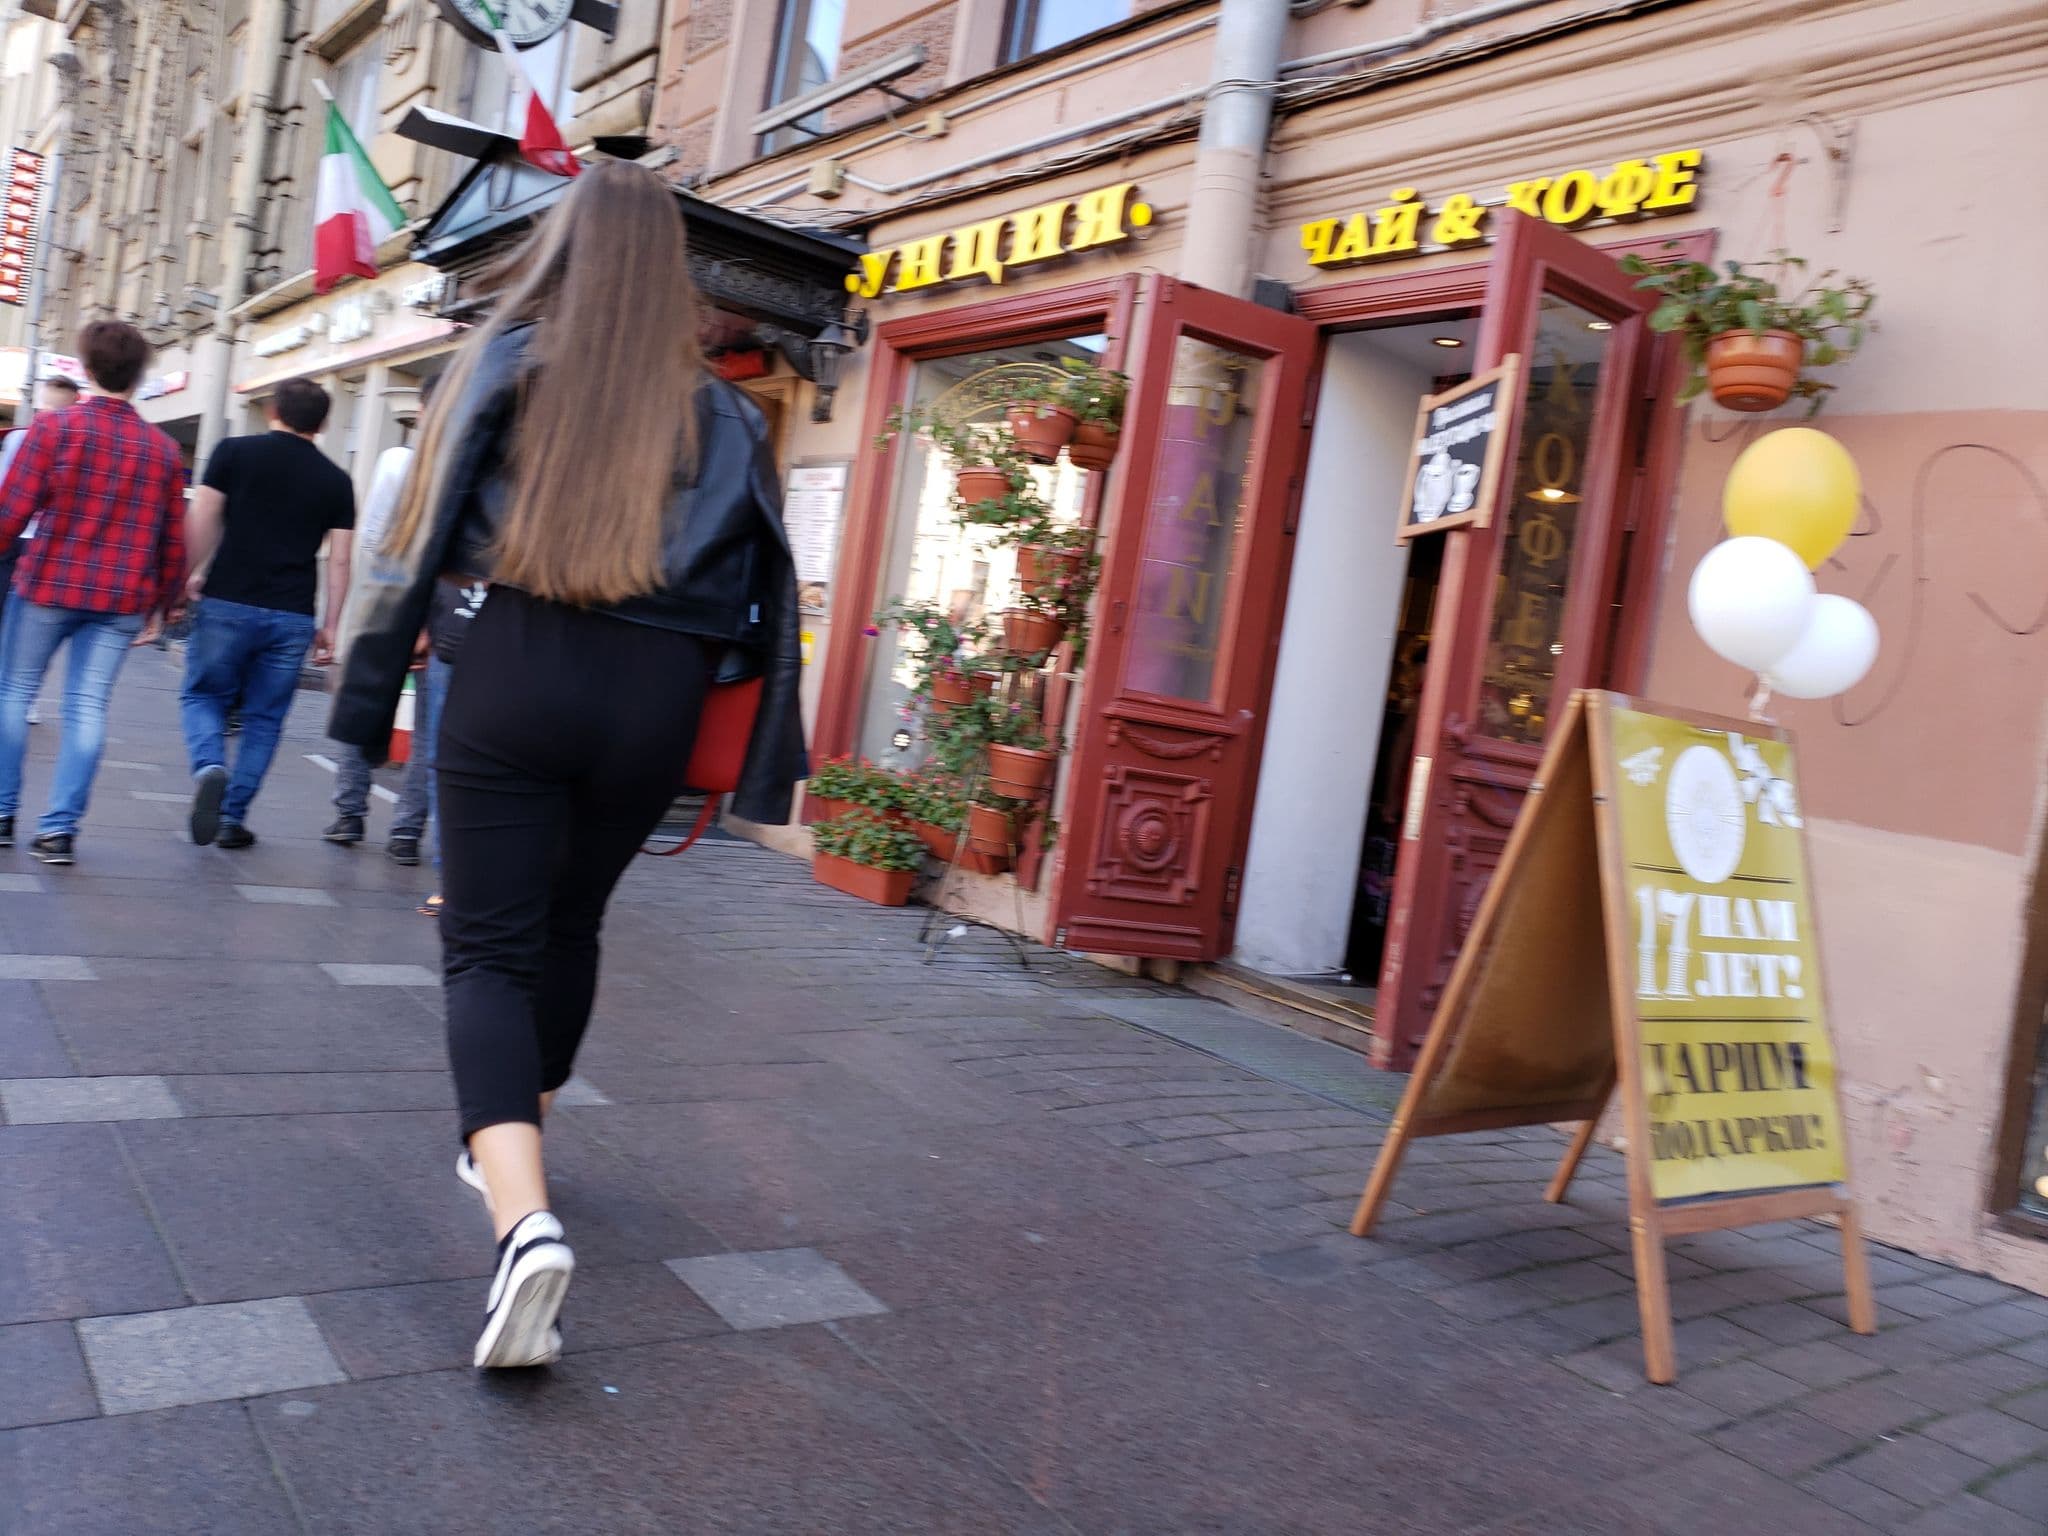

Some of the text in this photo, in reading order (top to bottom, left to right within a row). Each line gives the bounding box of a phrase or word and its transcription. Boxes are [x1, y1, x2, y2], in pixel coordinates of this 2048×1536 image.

[1301, 187, 1425, 265] ЧАЙ
[1431, 193, 1488, 245] &
[1635, 885, 1696, 1001] 17
